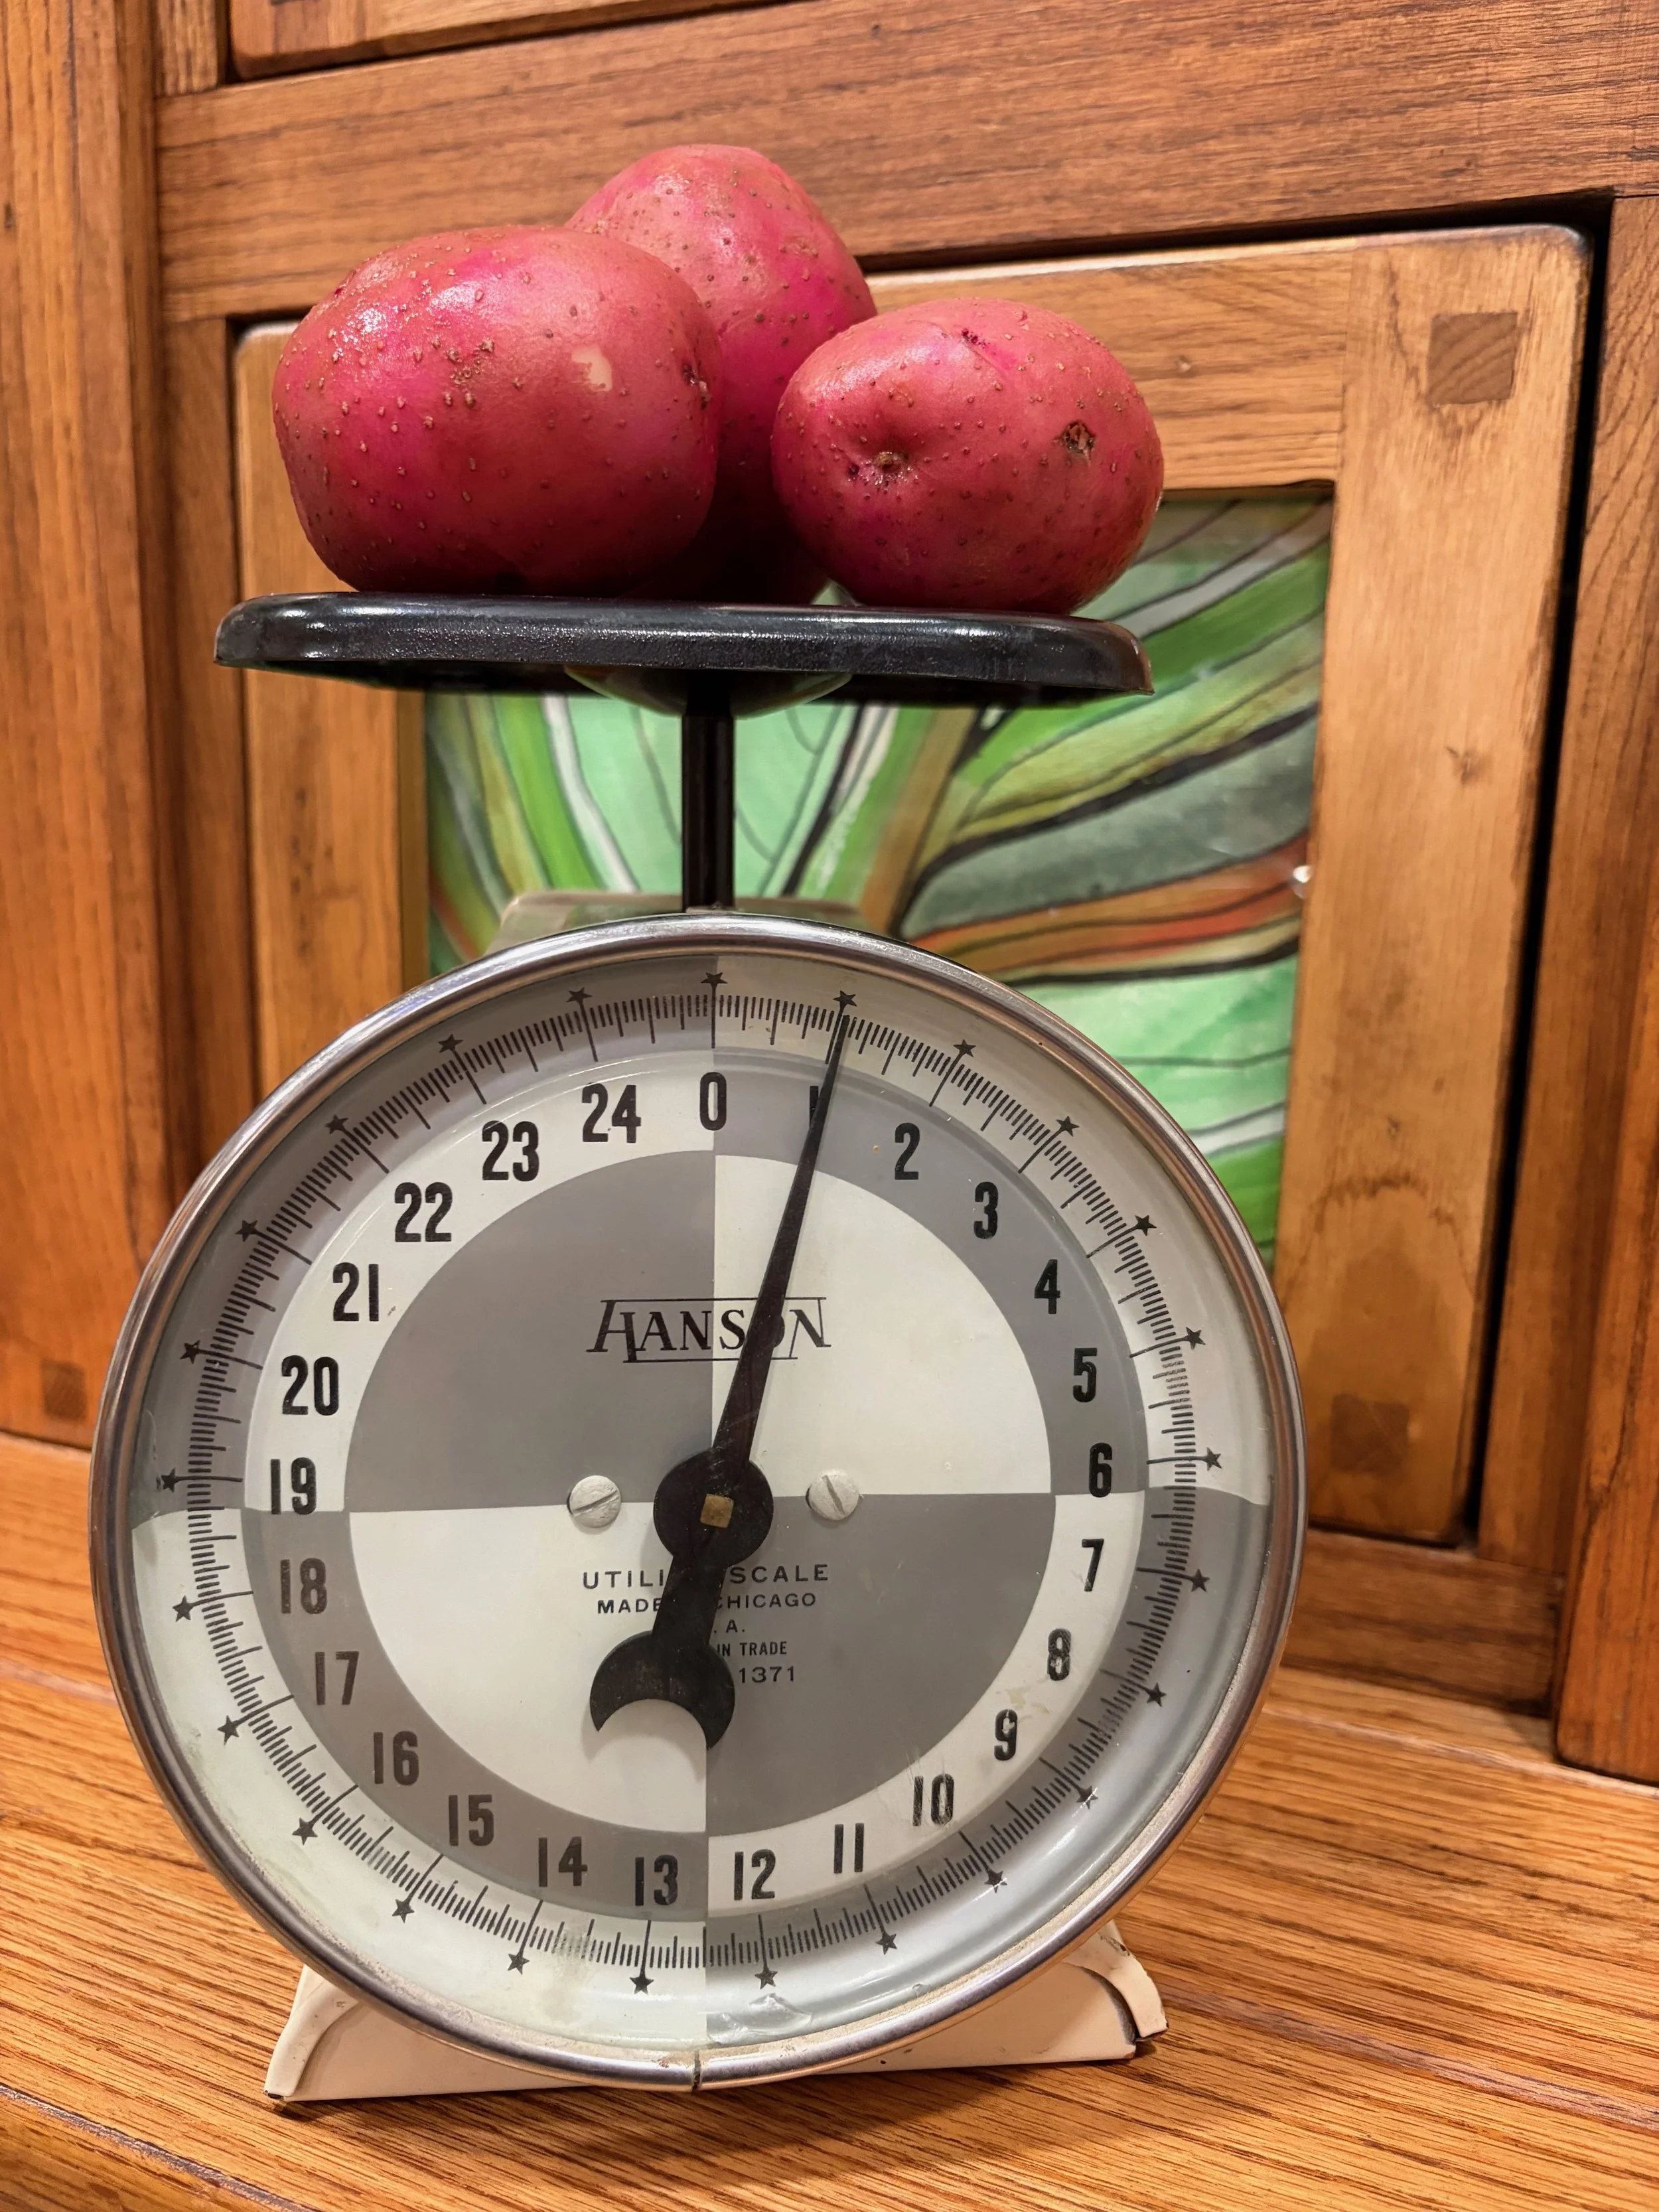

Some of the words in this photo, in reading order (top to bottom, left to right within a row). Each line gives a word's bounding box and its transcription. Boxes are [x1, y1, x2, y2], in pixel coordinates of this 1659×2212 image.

[582, 1083, 641, 1143] 24
[699, 1071, 727, 1131] 0
[482, 1120, 540, 1182] 23
[895, 1122, 920, 1181] 2
[395, 1182, 453, 1242] 22
[974, 1181, 999, 1240] 3
[332, 1262, 379, 1322] 21
[1034, 1259, 1061, 1315] 4
[586, 1297, 831, 1363] HANSN
[281, 1355, 339, 1416] 20
[1072, 1347, 1098, 1403] 5
[270, 1457, 316, 1515] 19
[1088, 1442, 1113, 1498] 6
[280, 1558, 327, 1615] 18
[583, 1569, 664, 1589] UTILI
[730, 1564, 828, 1584] SCALE
[1082, 1538, 1104, 1592] 7
[597, 1597, 662, 1613] MADE
[739, 1641, 788, 1657] TRADE
[739, 1666, 794, 1684] 1371
[1047, 1629, 1071, 1682] 8
[315, 1651, 359, 1706] 17
[373, 1730, 419, 1786] 16
[994, 1710, 1018, 1761] 9
[448, 1794, 494, 1847] 15
[913, 1775, 954, 1826] 10
[538, 1836, 588, 1887] 14
[734, 1849, 776, 1901] 12
[833, 1824, 864, 1874] 11
[634, 1854, 678, 1907] 13
